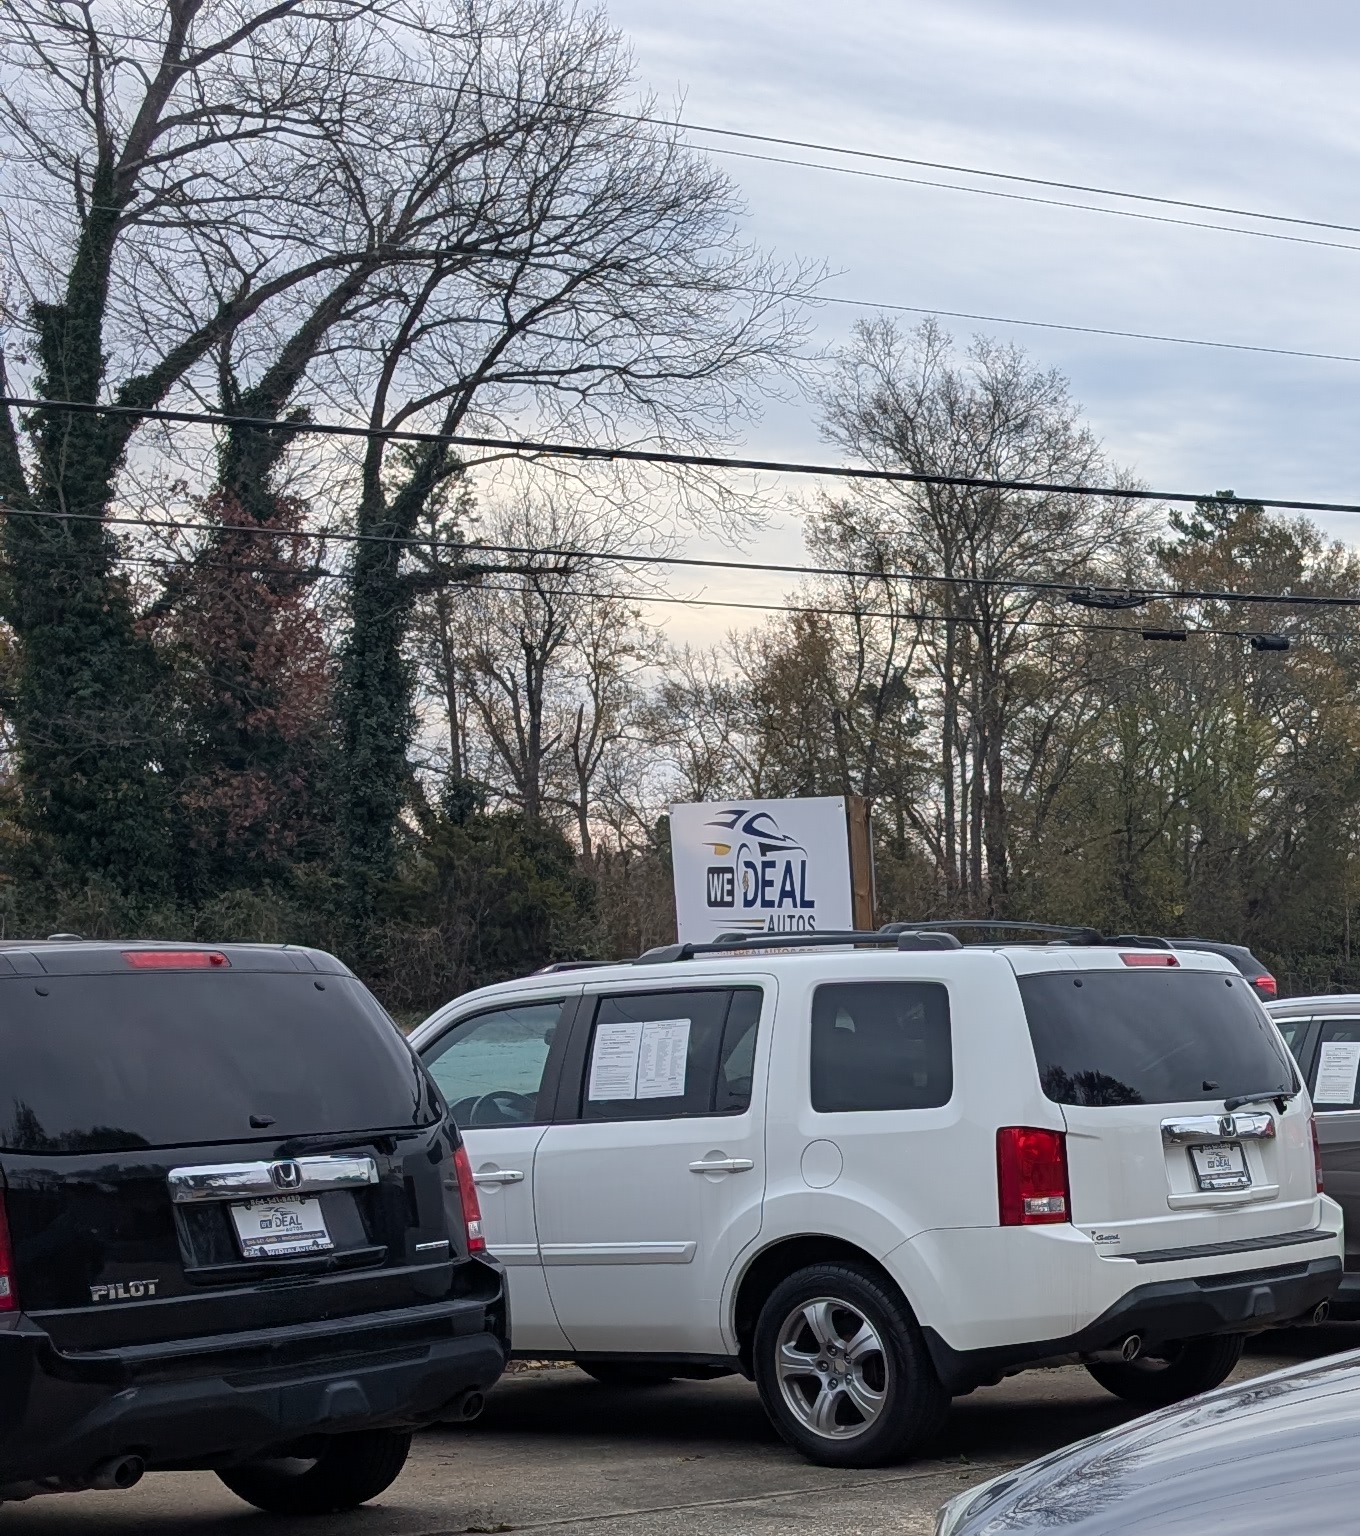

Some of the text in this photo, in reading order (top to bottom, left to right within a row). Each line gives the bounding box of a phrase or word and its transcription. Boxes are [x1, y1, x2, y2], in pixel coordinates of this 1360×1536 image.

[709, 860, 816, 908] WE DEAL
[767, 914, 816, 932] AUTOS
[275, 1214, 302, 1227] DEAL
[89, 1279, 159, 1301] PILOT
